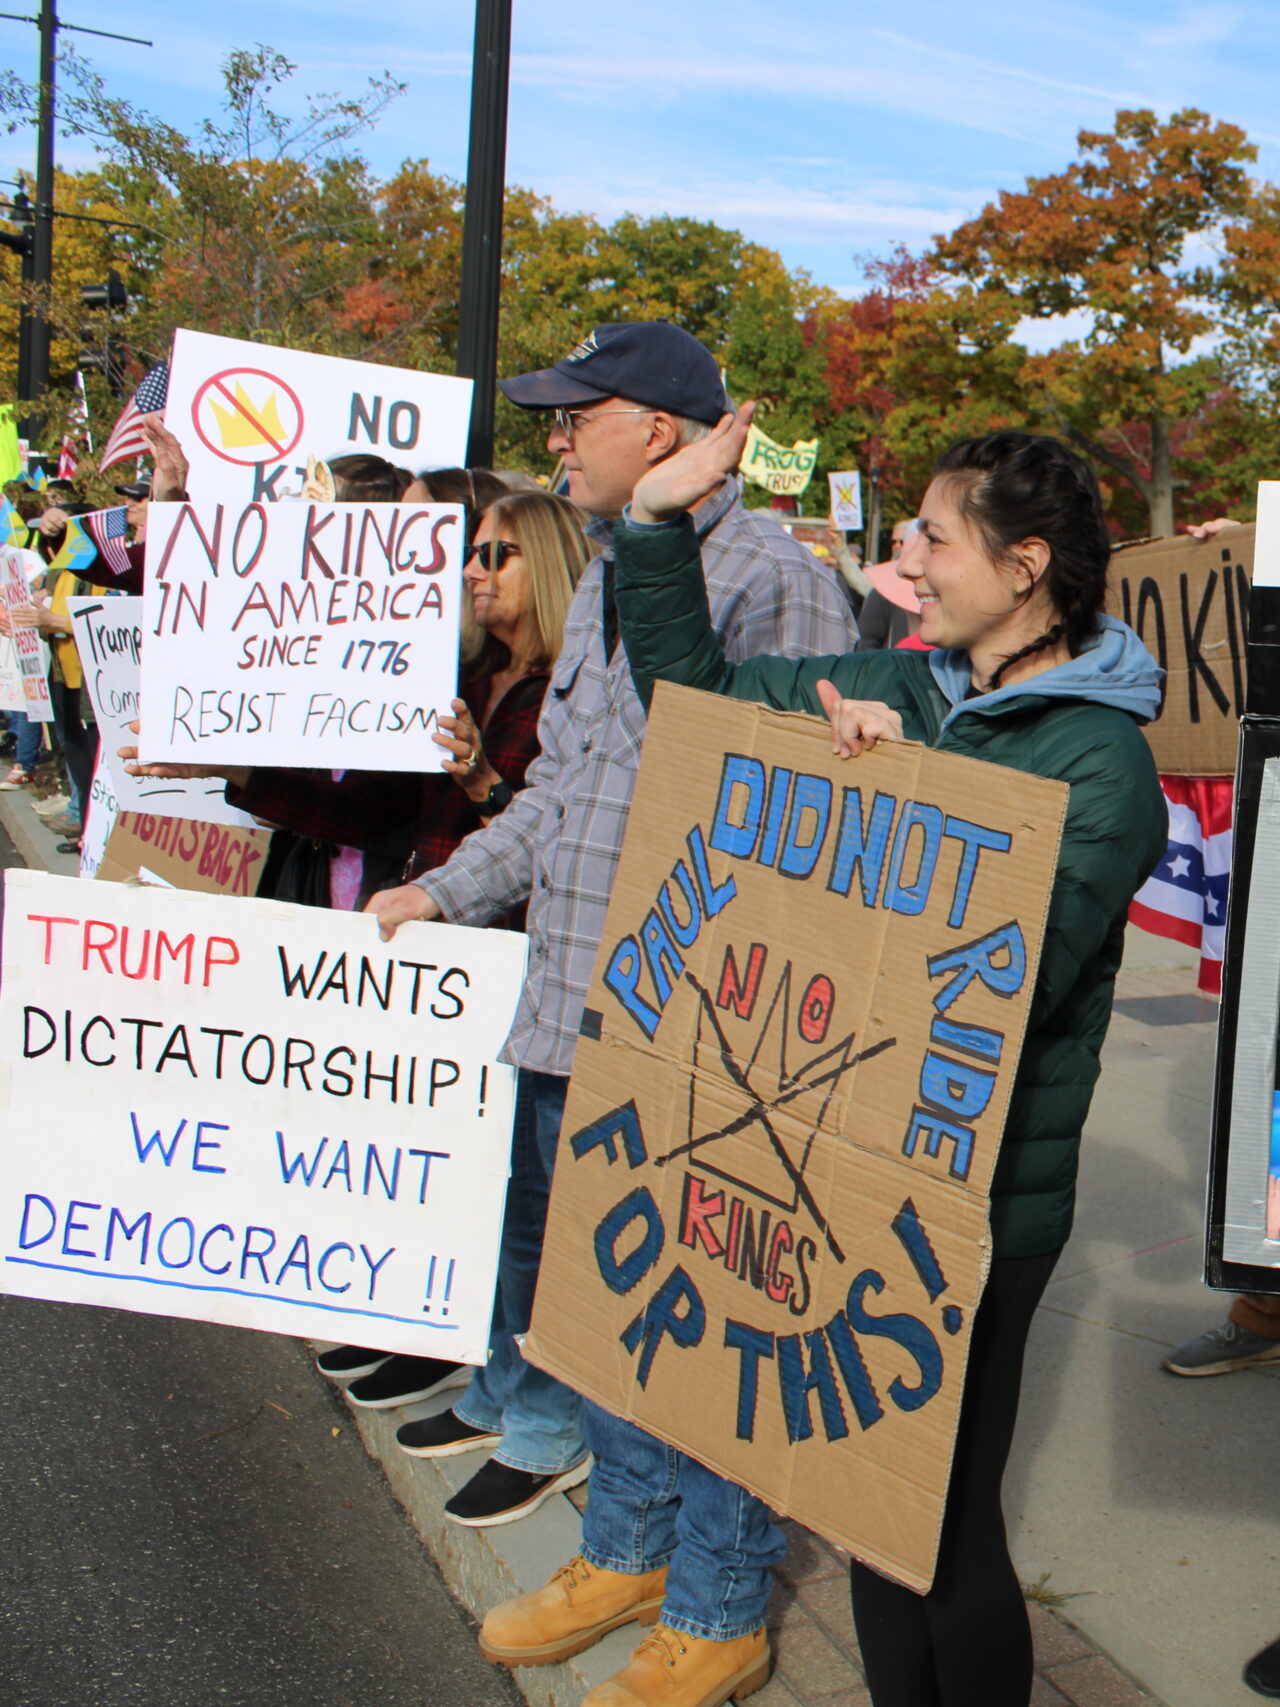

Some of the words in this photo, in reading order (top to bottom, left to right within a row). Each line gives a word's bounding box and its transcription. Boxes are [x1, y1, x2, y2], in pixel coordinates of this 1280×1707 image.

[347, 391, 420, 450] NO
[750, 440, 817, 470] FROG
[155, 503, 267, 580] NO
[301, 504, 458, 580] KINGS
[154, 581, 207, 637] IN
[231, 580, 443, 633] AMERICA
[237, 635, 322, 670] SINCE
[342, 639, 412, 676] 1776
[170, 686, 287, 746] RESIST
[302, 693, 440, 738] FACISM
[196, 821, 262, 897] BACK
[709, 752, 833, 880] DID
[826, 786, 1012, 929] NOT
[27, 914, 240, 987] TRUMP
[277, 945, 470, 1020] WANTS
[602, 823, 738, 1043] PAUL
[716, 943, 835, 1043] NO
[902, 919, 1027, 1181] RIDE
[131, 1112, 230, 1174] WE
[276, 1131, 451, 1204] WANT
[19, 1194, 396, 1301] DEMOCRACY
[571, 1098, 706, 1391] FOR
[724, 1197, 964, 1446] THIS!
[679, 1171, 816, 1316] KINGS
